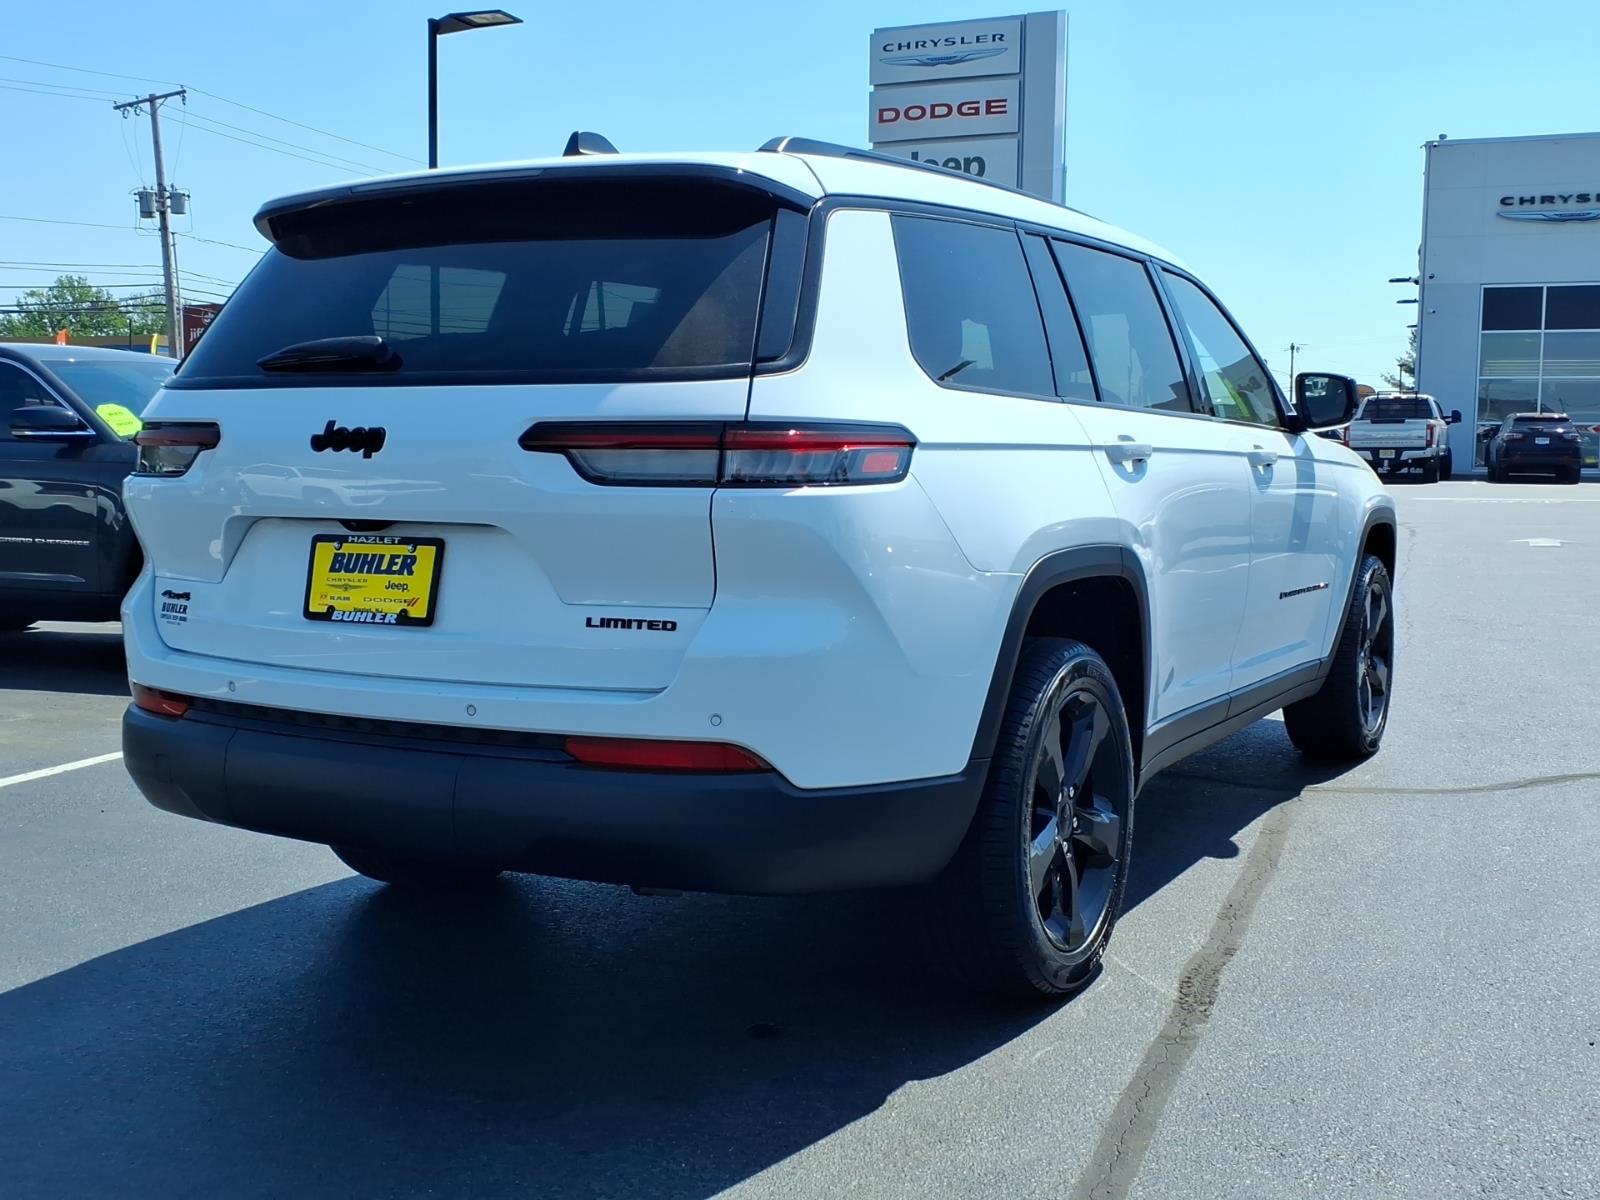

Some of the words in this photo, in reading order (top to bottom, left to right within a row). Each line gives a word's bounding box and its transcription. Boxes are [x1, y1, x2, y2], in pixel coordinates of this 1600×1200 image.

[882, 33, 1005, 52] CHRYSLER
[878, 98, 1008, 124] DODGE
[310, 419, 387, 459] Jeep
[34, 538, 91, 546] CHEROKEE
[348, 535, 401, 545] HAZLET
[329, 552, 417, 576] BUHLER
[384, 580, 409, 593] Jeep
[363, 596, 411, 604] DODGE
[161, 602, 188, 615] BUHLER
[331, 610, 398, 624] BUHLER
[585, 617, 677, 631] LIMITED
